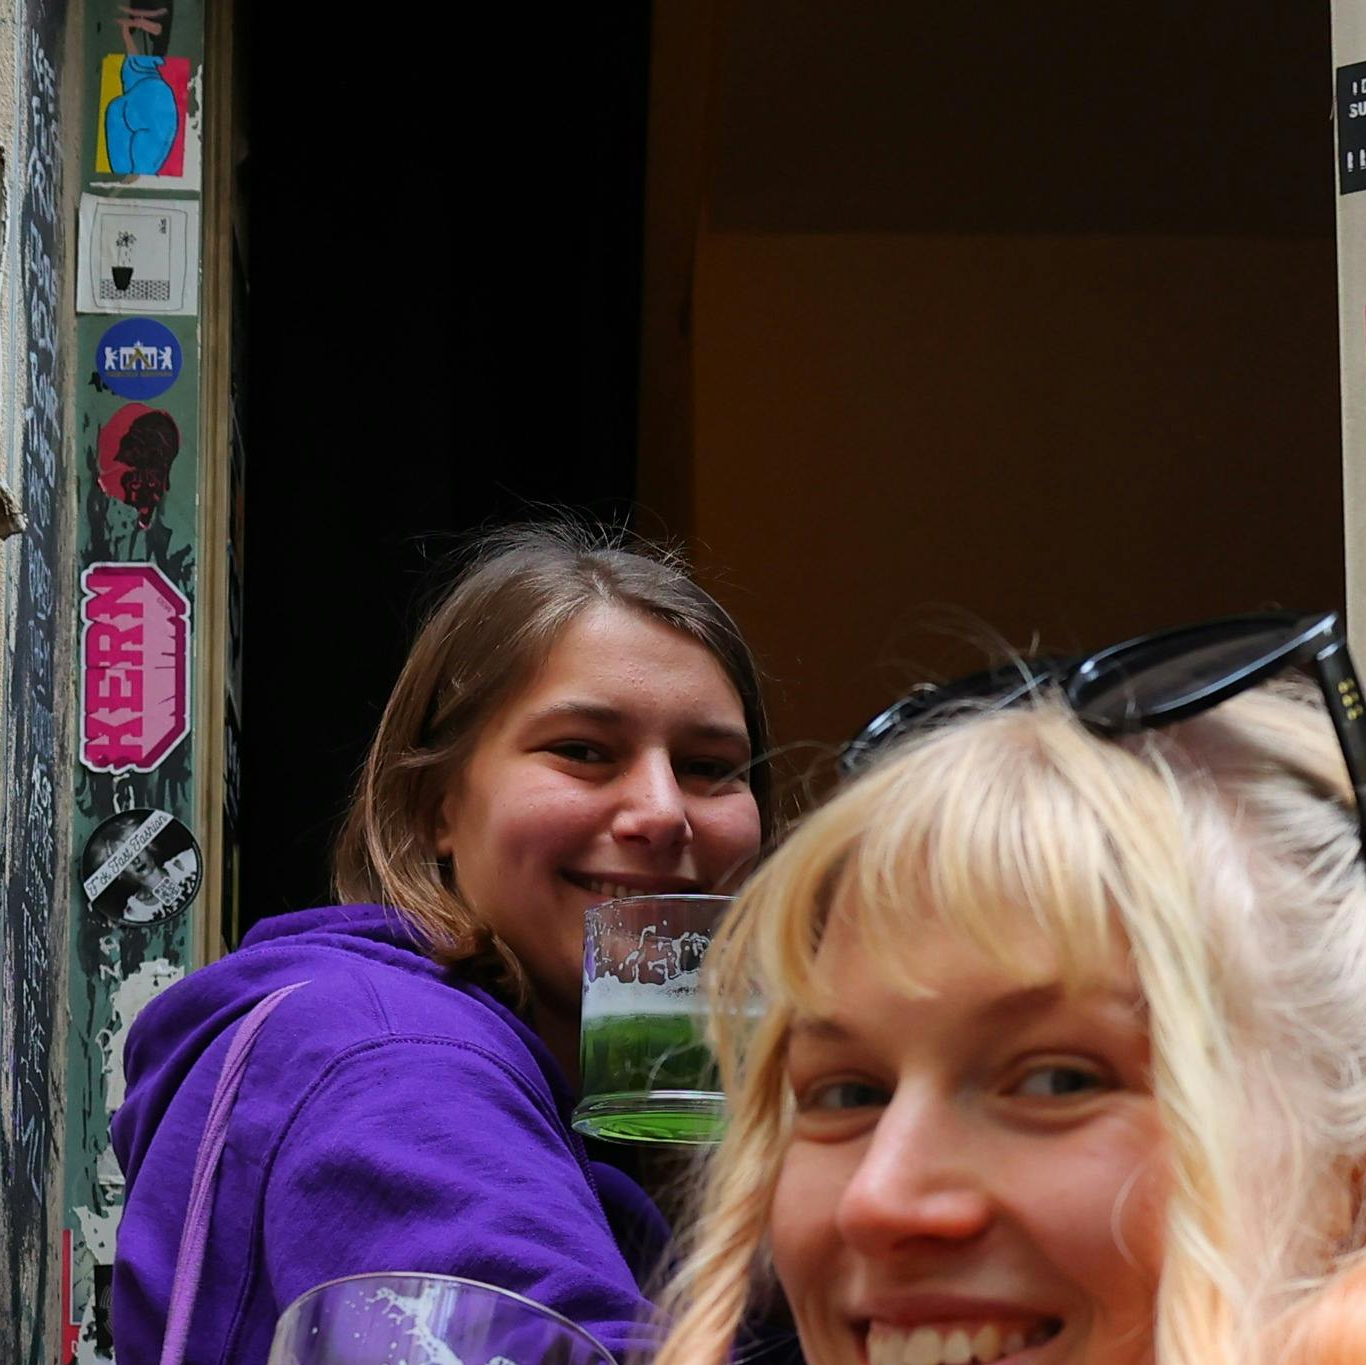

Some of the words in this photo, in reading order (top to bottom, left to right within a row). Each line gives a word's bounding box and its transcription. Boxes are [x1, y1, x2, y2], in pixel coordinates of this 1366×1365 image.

[1352, 81, 1358, 97] I
[1346, 151, 1354, 173] I
[84, 568, 146, 768] KERN
